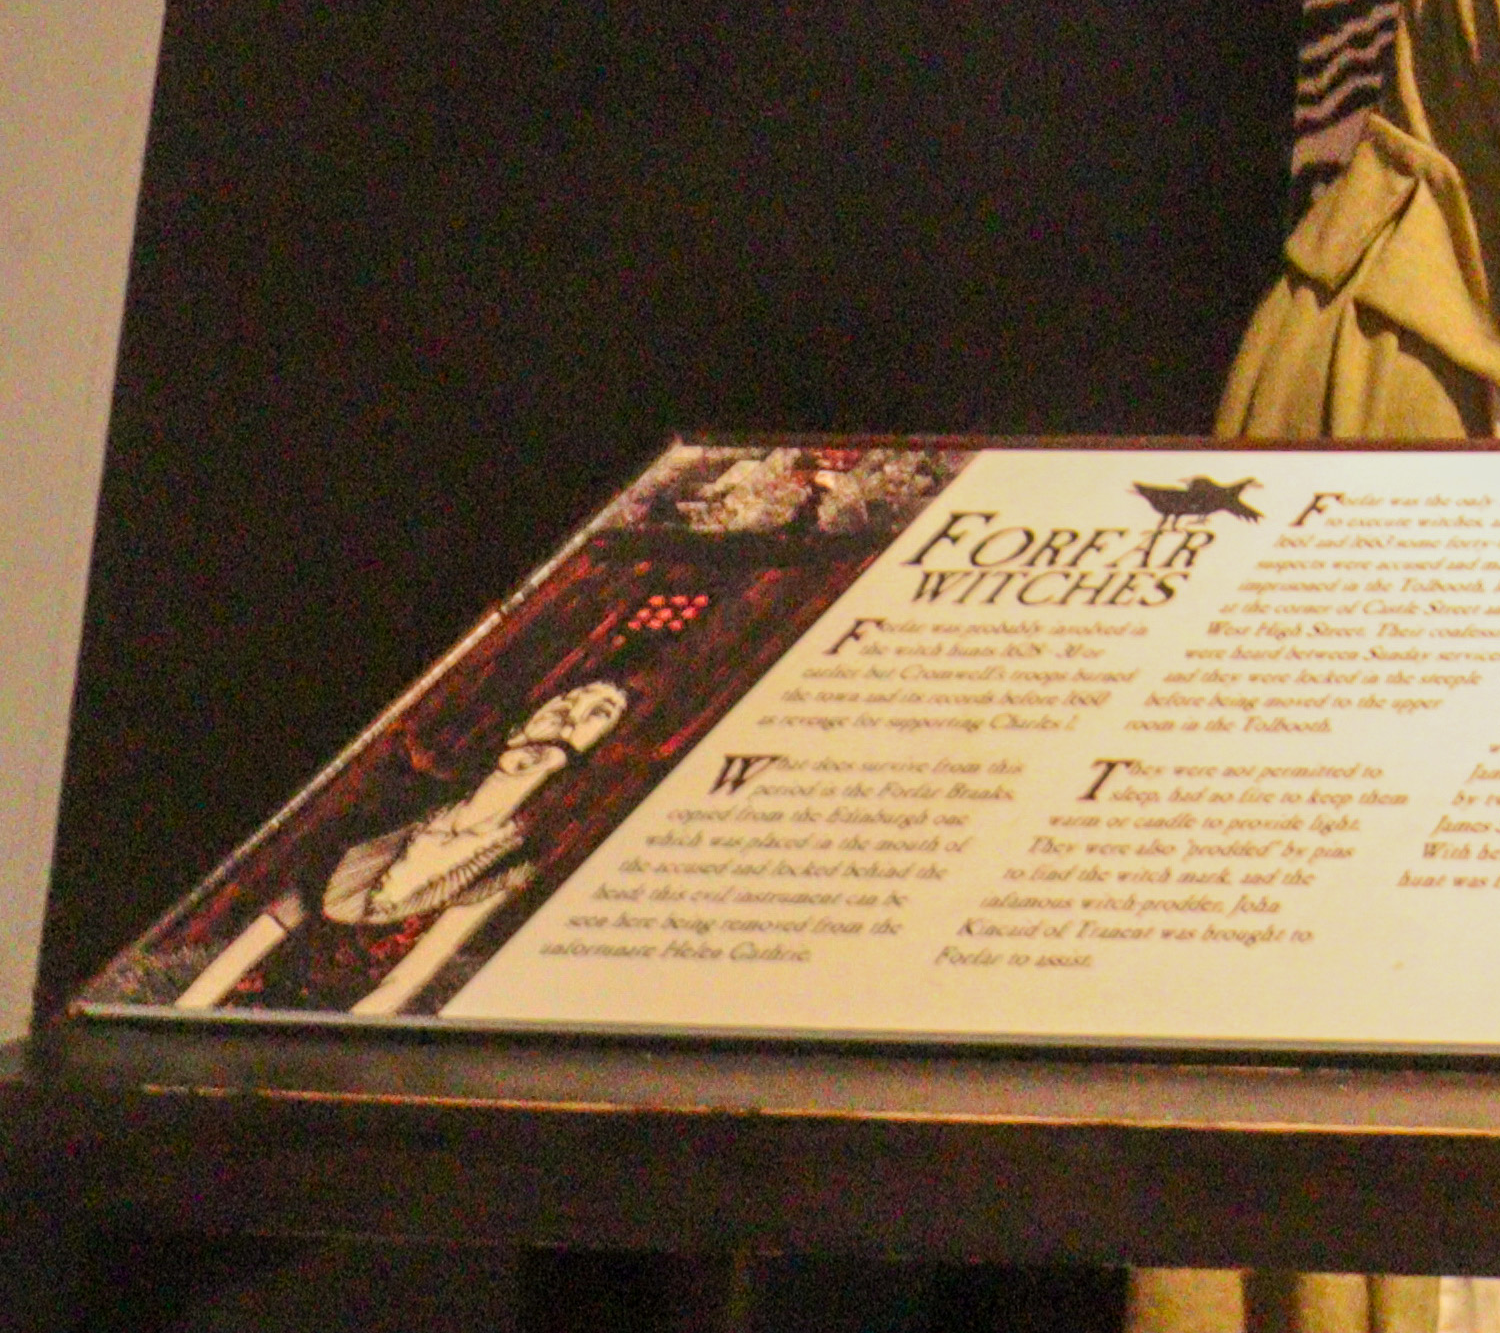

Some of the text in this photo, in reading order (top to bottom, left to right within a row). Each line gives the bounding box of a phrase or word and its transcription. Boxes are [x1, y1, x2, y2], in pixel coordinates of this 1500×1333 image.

[902, 510, 1214, 568] FORFAR
[912, 568, 1189, 606] WITCHES
[1450, 789, 1480, 809] by
[1430, 814, 1492, 835] James
[1396, 869, 1447, 888] hunt
[1452, 876, 1489, 889] was
